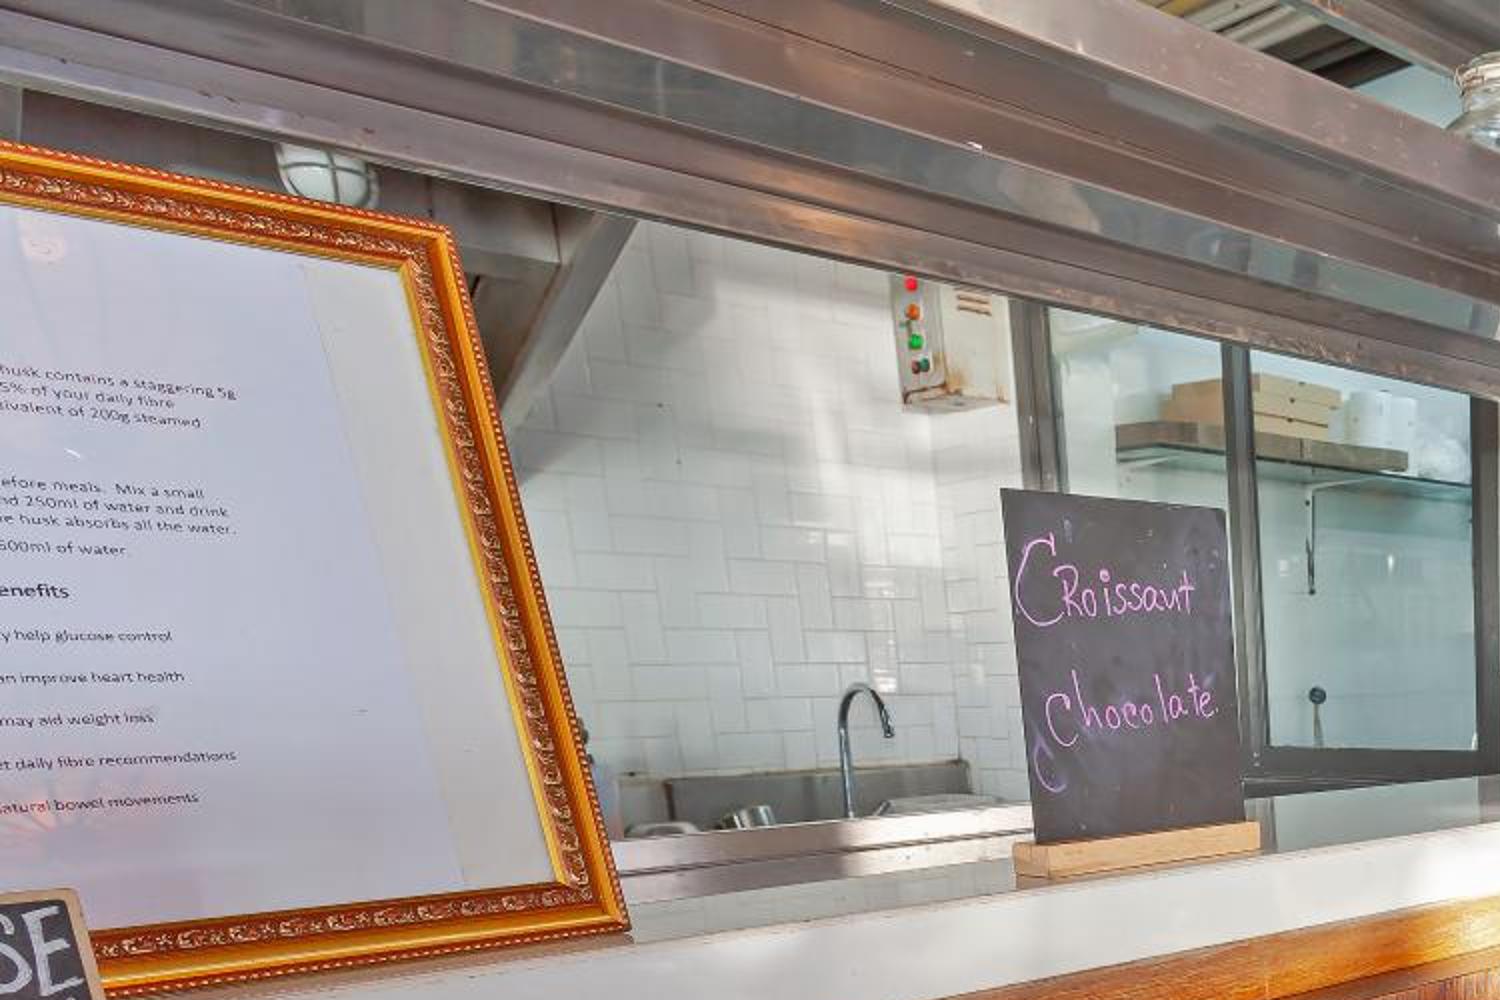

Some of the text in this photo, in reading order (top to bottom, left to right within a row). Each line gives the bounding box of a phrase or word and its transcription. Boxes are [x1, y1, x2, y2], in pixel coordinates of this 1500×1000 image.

[0, 364, 41, 378] husk
[45, 371, 114, 386] contains
[120, 379, 129, 388] a
[133, 380, 215, 399] staggering
[31, 385, 46, 398] of
[52, 388, 88, 401] your
[95, 393, 132, 407] daily
[137, 396, 175, 408] fibre
[67, 406, 84, 417] of
[90, 407, 130, 424] 200g
[133, 413, 200, 429] steamed
[115, 483, 146, 497] Mix
[151, 487, 159, 497] a
[163, 489, 205, 499] small
[83, 499, 99, 511] of
[104, 503, 150, 513] water
[155, 504, 184, 515] and
[189, 506, 228, 517] drink
[19, 514, 60, 527] husk
[65, 515, 129, 530] absorbs
[133, 519, 152, 531] all
[157, 521, 183, 533] the
[56, 541, 73, 555] of
[13, 629, 50, 644] help
[55, 629, 114, 644] glucose
[118, 631, 172, 642] control
[20, 672, 87, 686] improve
[90, 671, 133, 683] heart
[137, 671, 185, 683] health
[40, 713, 63, 726] aid
[67, 712, 120, 727] weight
[124, 711, 155, 723] loss
[16, 757, 53, 771] daily
[57, 755, 95, 768] fibre
[99, 752, 237, 767] recommendations
[54, 798, 105, 811] bowel
[108, 792, 200, 809] movements
